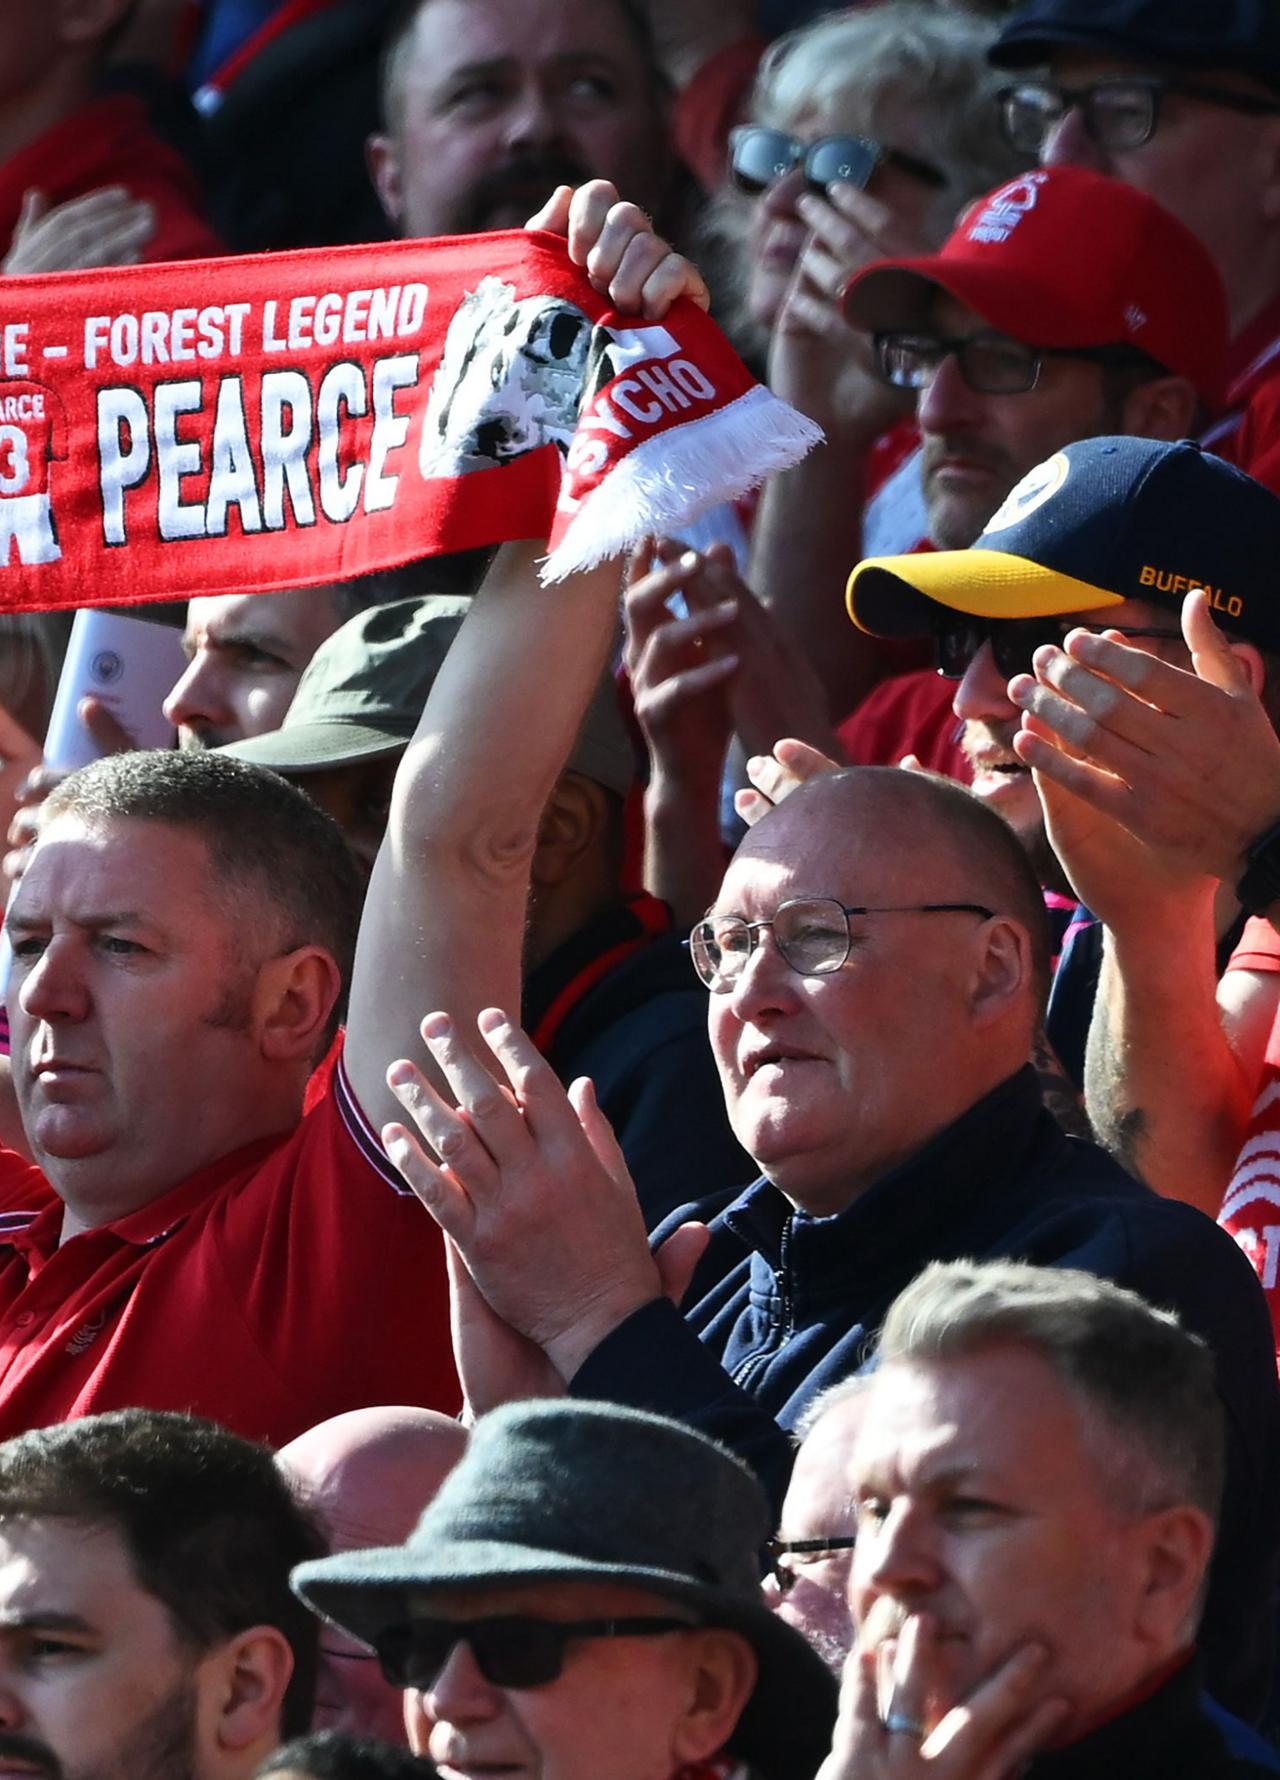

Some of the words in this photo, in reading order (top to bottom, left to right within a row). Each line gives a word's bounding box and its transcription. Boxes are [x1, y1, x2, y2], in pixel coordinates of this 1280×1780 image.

[84, 303, 250, 370] FOREST
[262, 282, 429, 353] LEGEND
[96, 353, 420, 547] PEARCE
